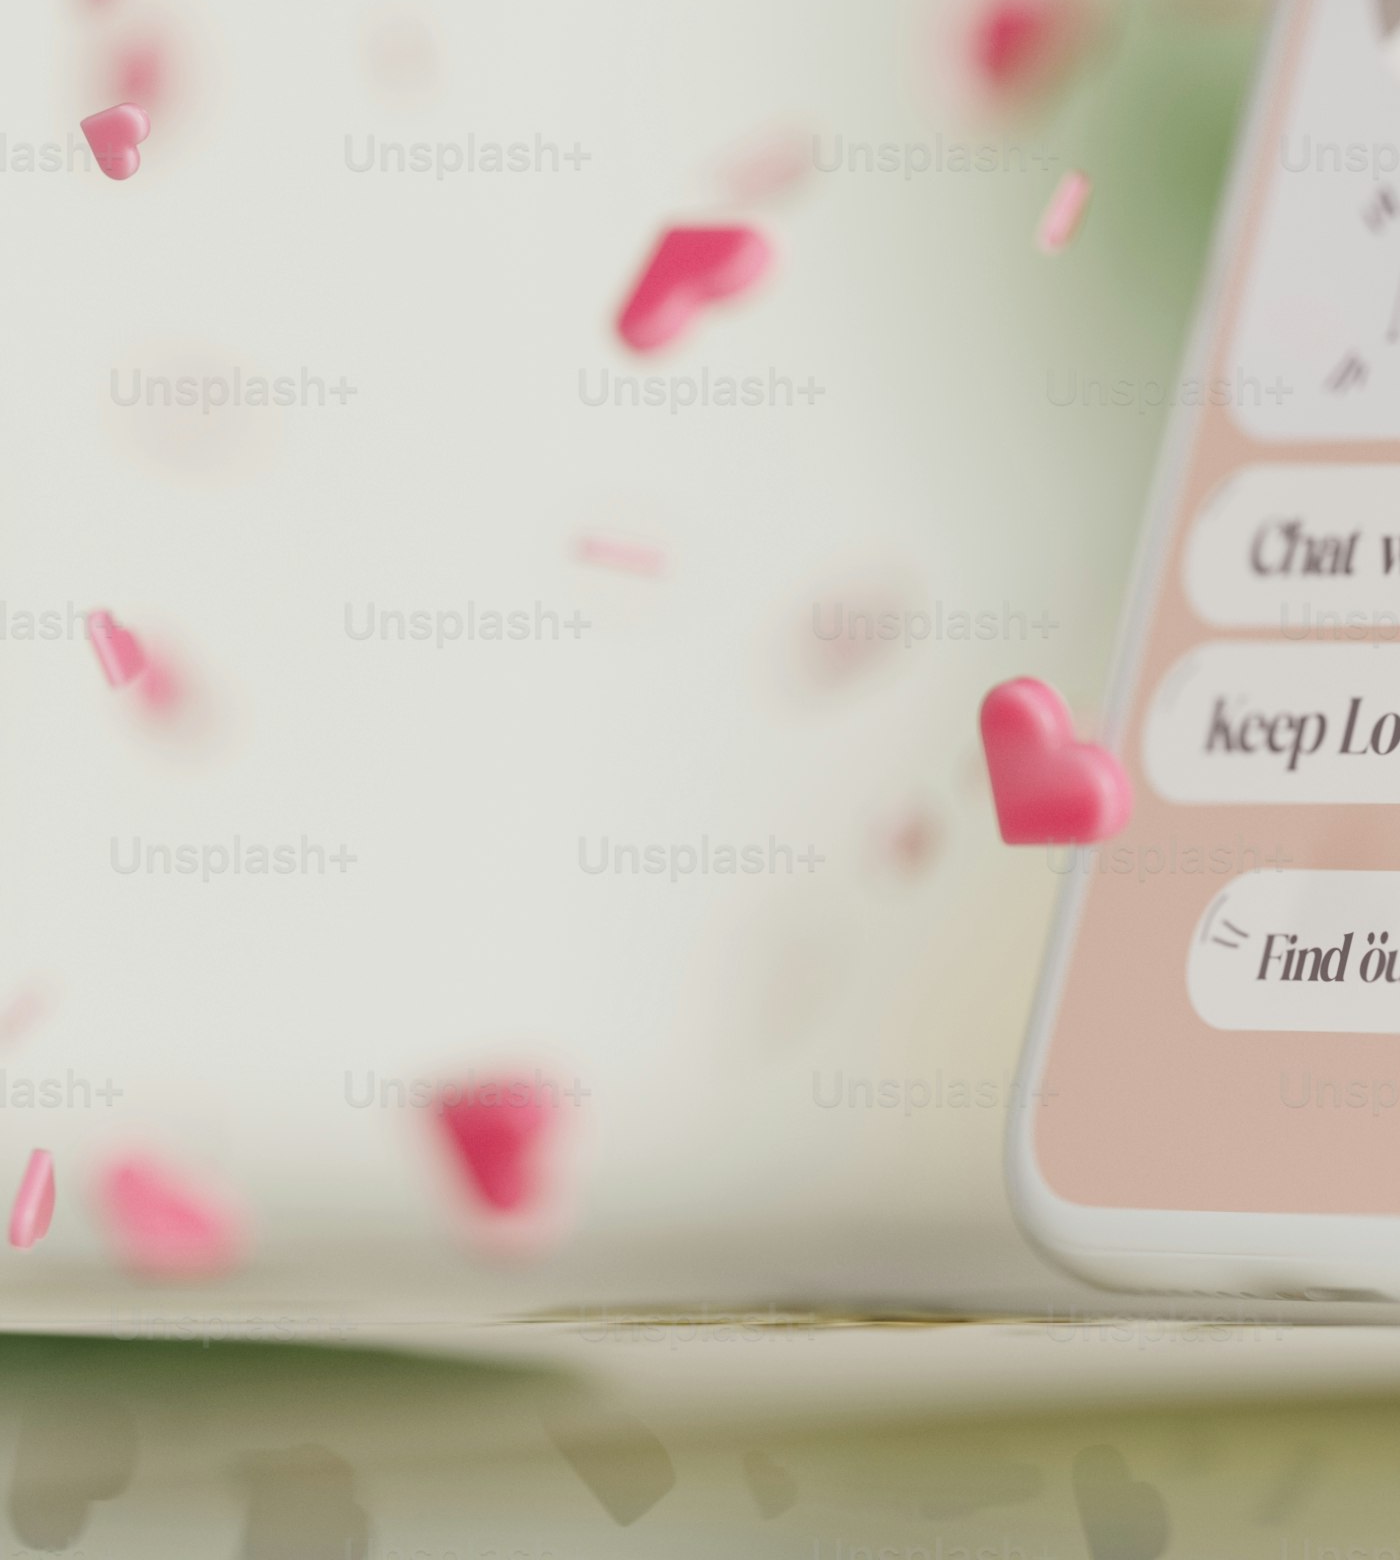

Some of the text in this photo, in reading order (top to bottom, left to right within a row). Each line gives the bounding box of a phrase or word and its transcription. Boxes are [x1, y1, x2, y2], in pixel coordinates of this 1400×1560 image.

[1248, 513, 1360, 577] Chat
[1203, 695, 1327, 773] Keep
[1256, 931, 1354, 983] Find
